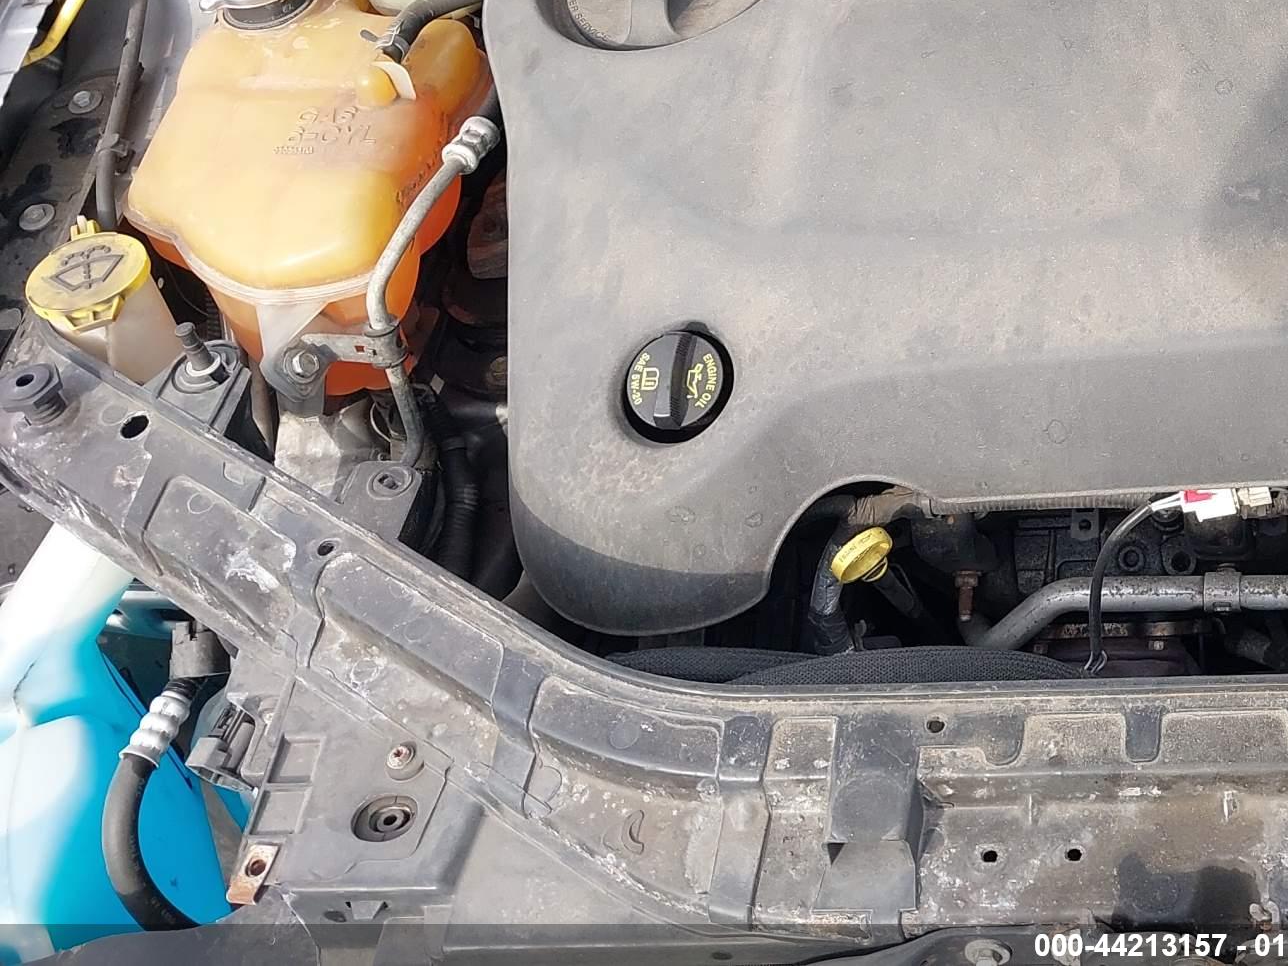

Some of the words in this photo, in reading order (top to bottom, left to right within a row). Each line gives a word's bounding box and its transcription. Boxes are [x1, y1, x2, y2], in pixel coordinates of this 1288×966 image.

[575, 13, 610, 42] SERVICE
[634, 353, 650, 372] SAE
[703, 354, 717, 392] ENGINE
[631, 374, 643, 405] 5W-20
[695, 392, 712, 408] OIL
